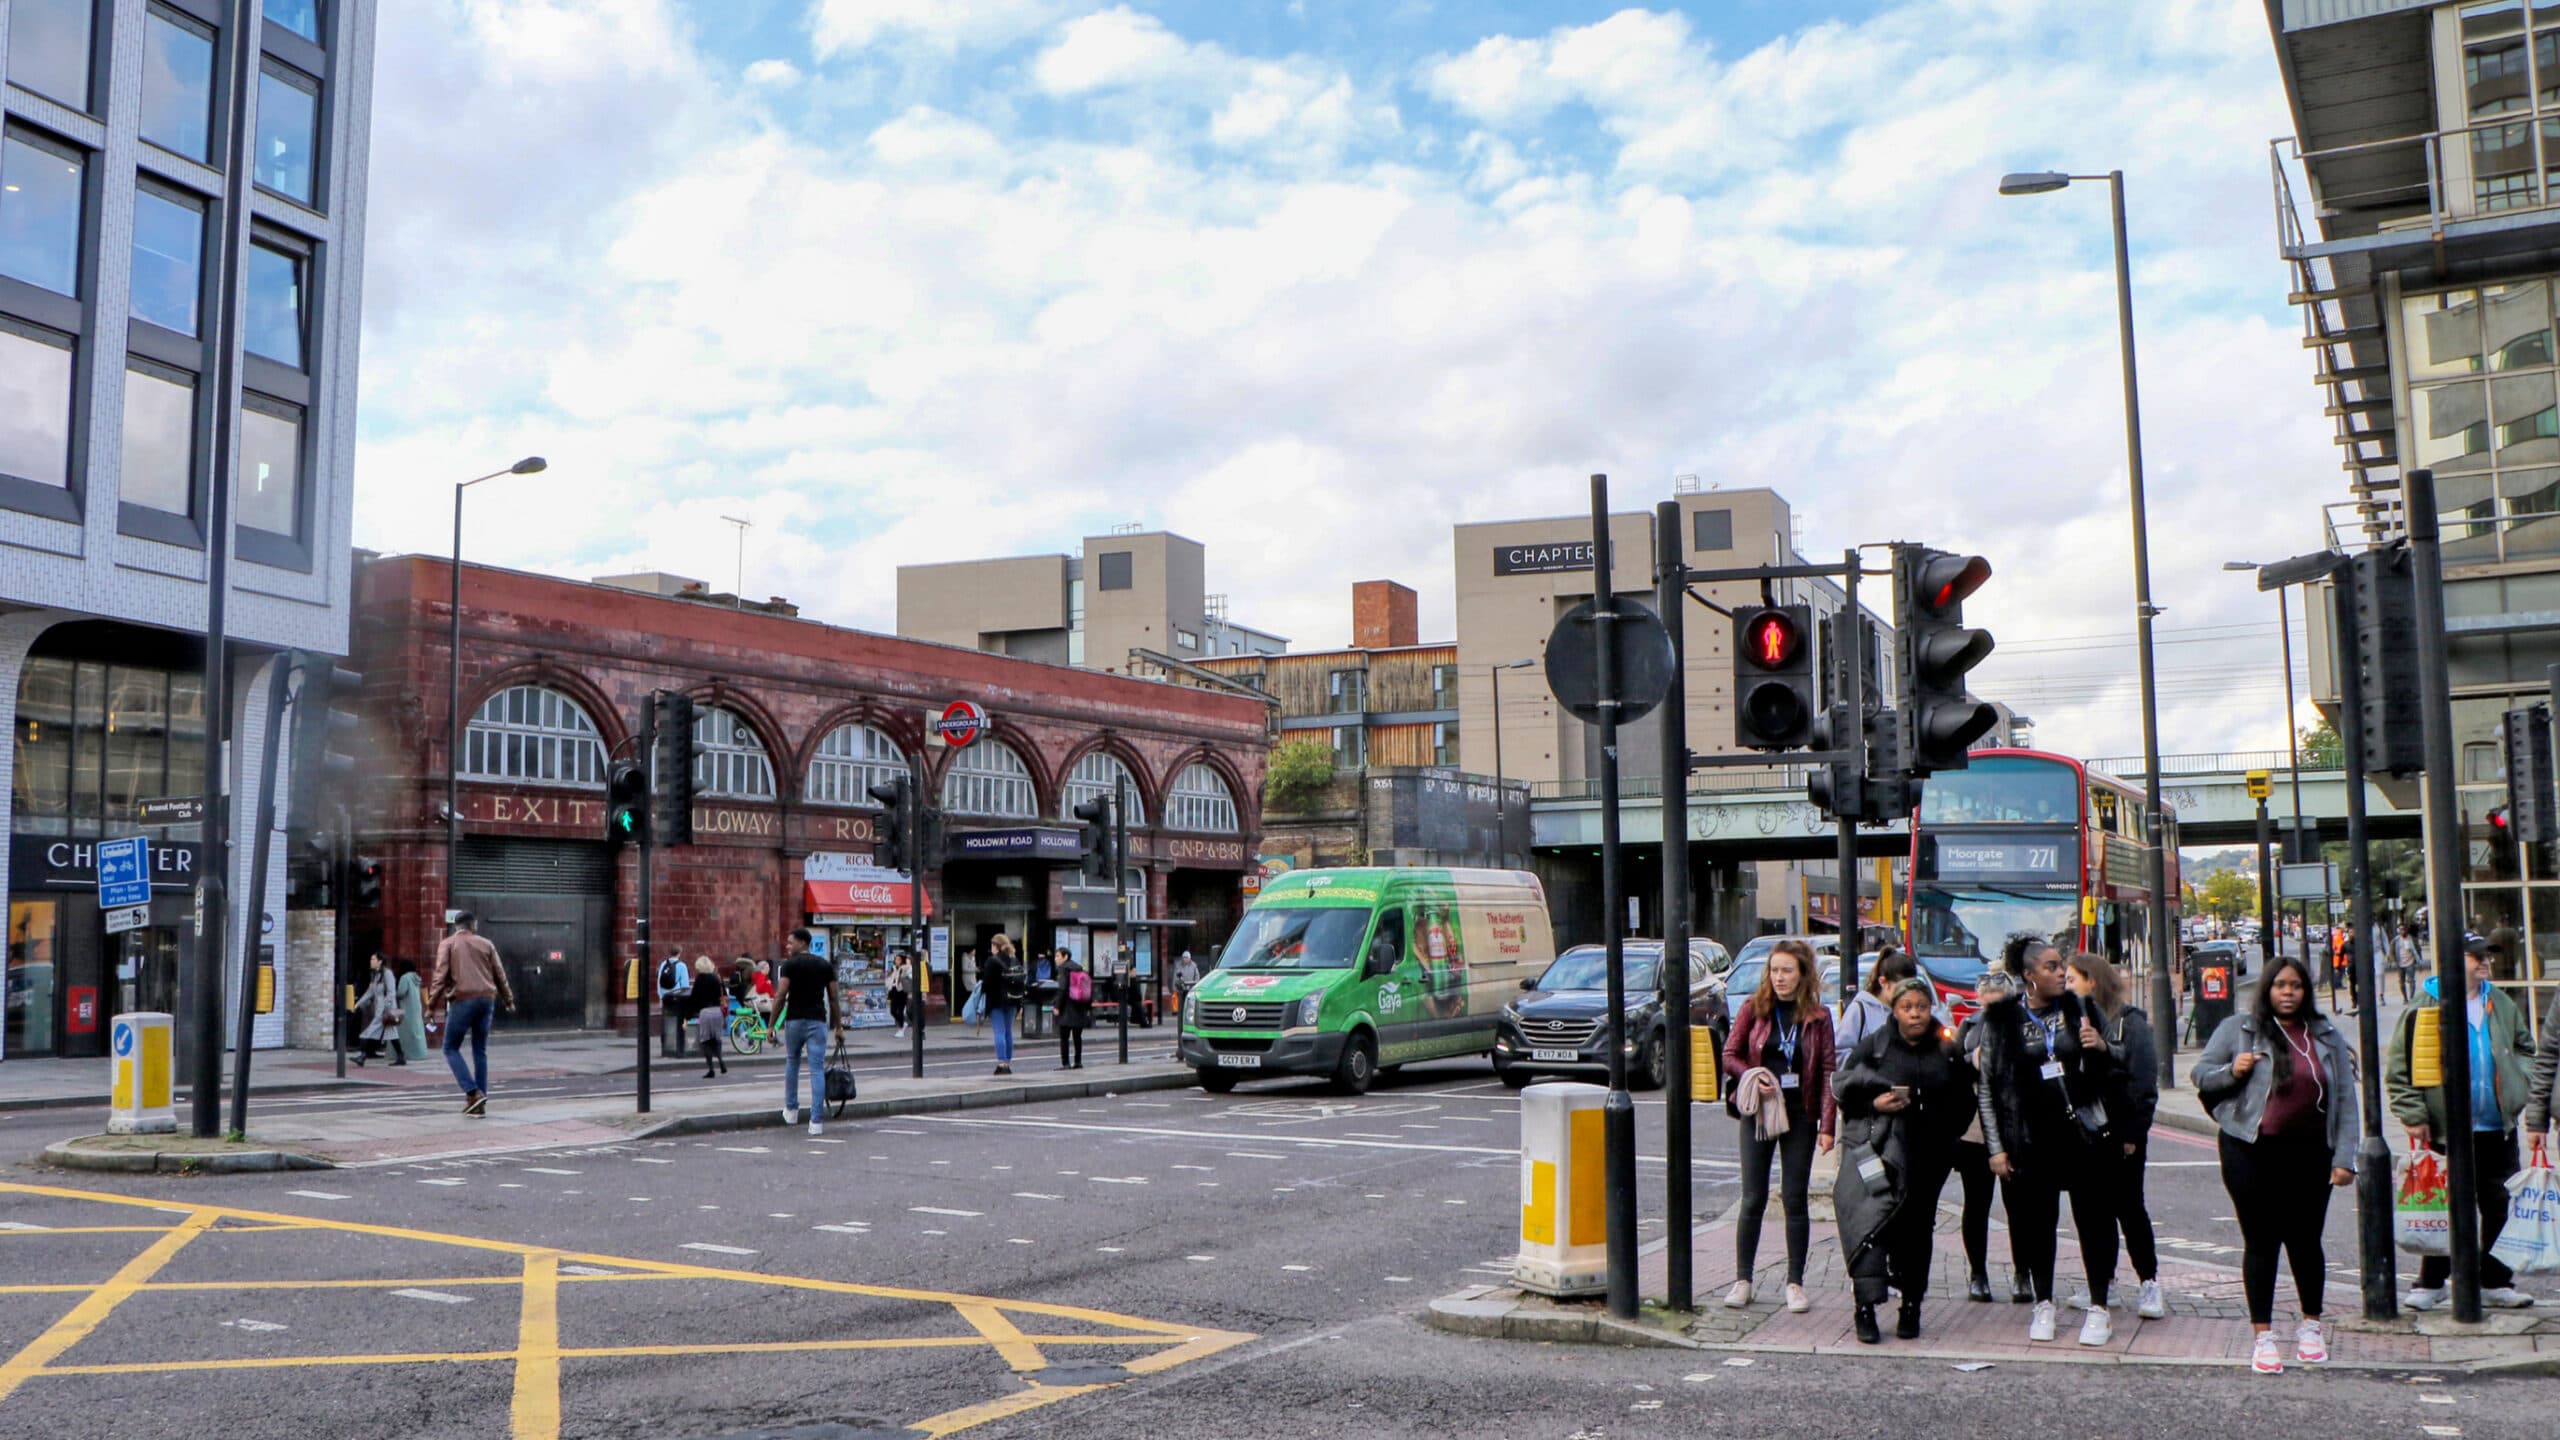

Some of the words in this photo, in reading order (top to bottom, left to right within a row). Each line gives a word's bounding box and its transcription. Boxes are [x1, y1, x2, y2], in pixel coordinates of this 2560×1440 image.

[1509, 545, 1595, 564] CHAPTER
[938, 718, 979, 729] UNDERGROUND
[494, 796, 587, 825] EXIT
[691, 809, 773, 834] LLOWAY
[836, 818, 881, 842] ROA
[966, 836, 1008, 848] HOLLOWAY
[1010, 836, 1032, 847] ROAD
[1041, 836, 1076, 847] HOLLOWAY
[47, 842, 193, 873] CHER
[1948, 848, 2003, 861] Moorgate
[2029, 848, 2055, 868] 271
[1486, 912, 1498, 925] The
[1378, 990, 1402, 1015] Gaya
[2406, 1219, 2448, 1229] TESCO
